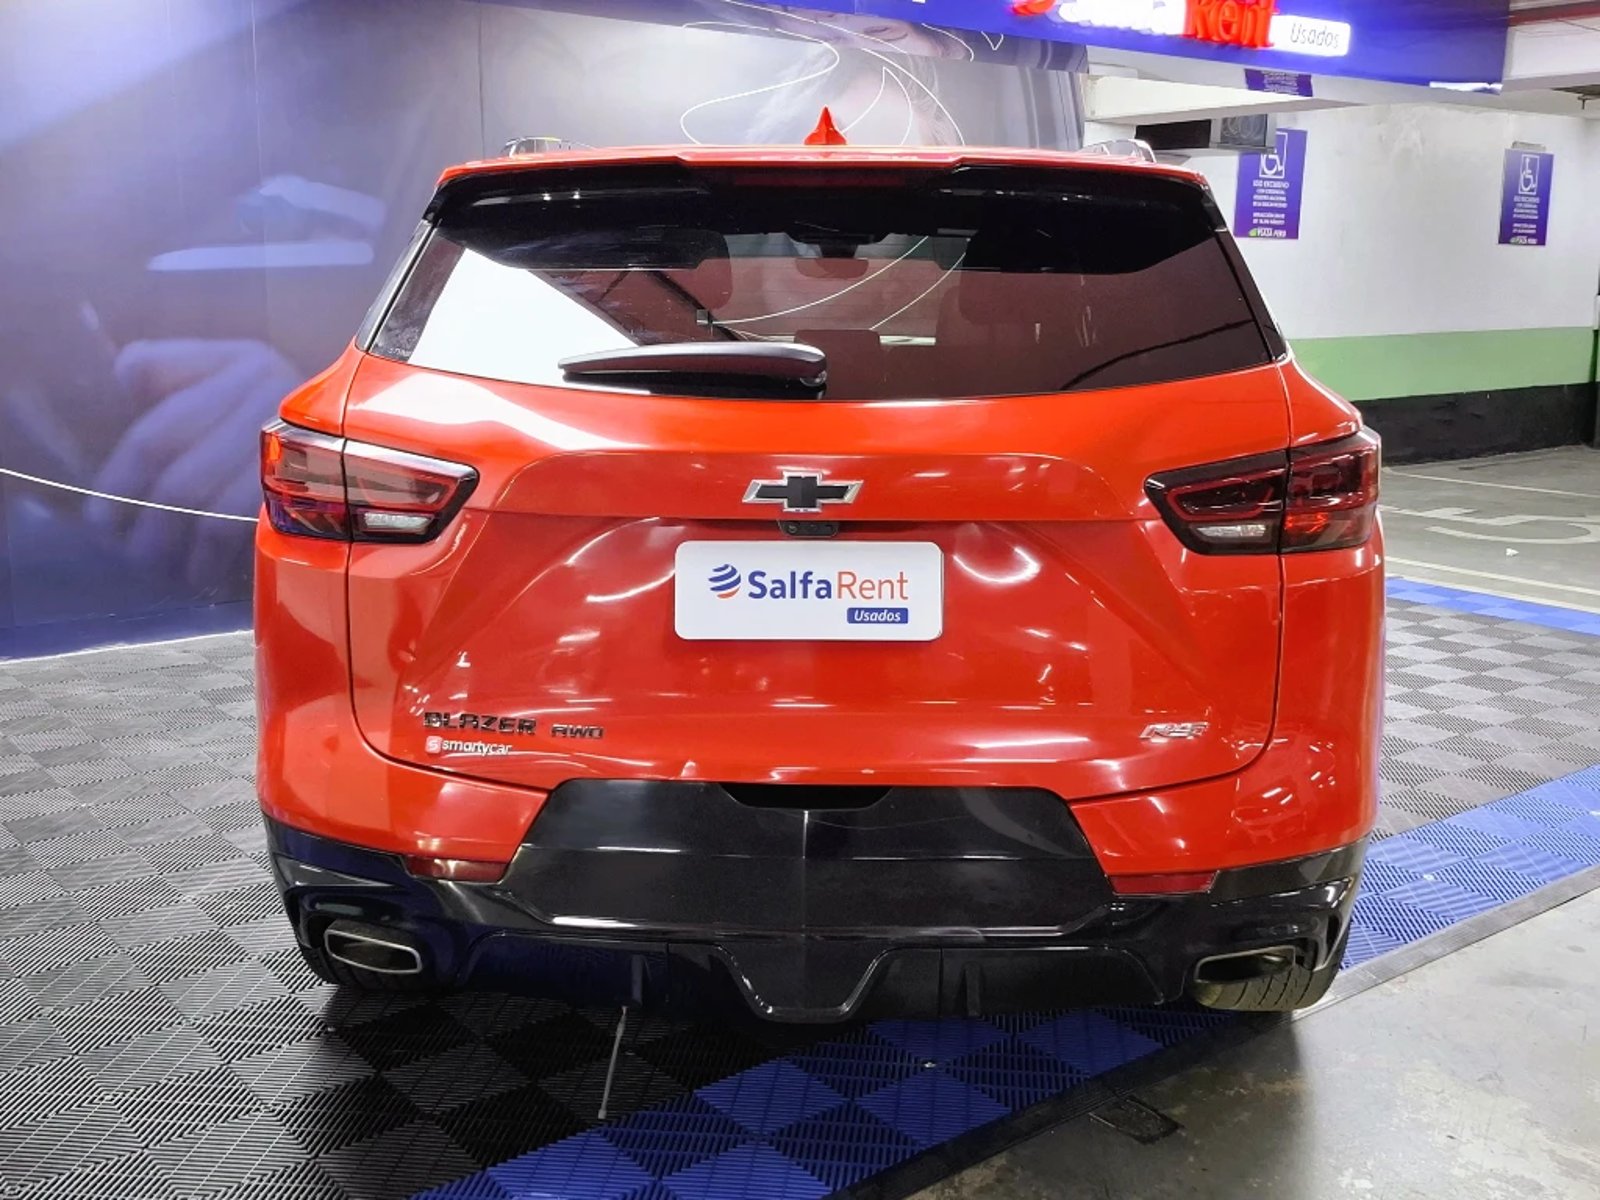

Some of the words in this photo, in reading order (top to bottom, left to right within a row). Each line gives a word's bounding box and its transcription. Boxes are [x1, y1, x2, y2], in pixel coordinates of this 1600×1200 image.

[1290, 23, 1339, 49] Usados
[748, 570, 909, 600] SalfaRent
[854, 609, 901, 622] Usados
[424, 712, 537, 735] BLAZER
[551, 724, 605, 739] AWD
[442, 740, 512, 756] smartycar
